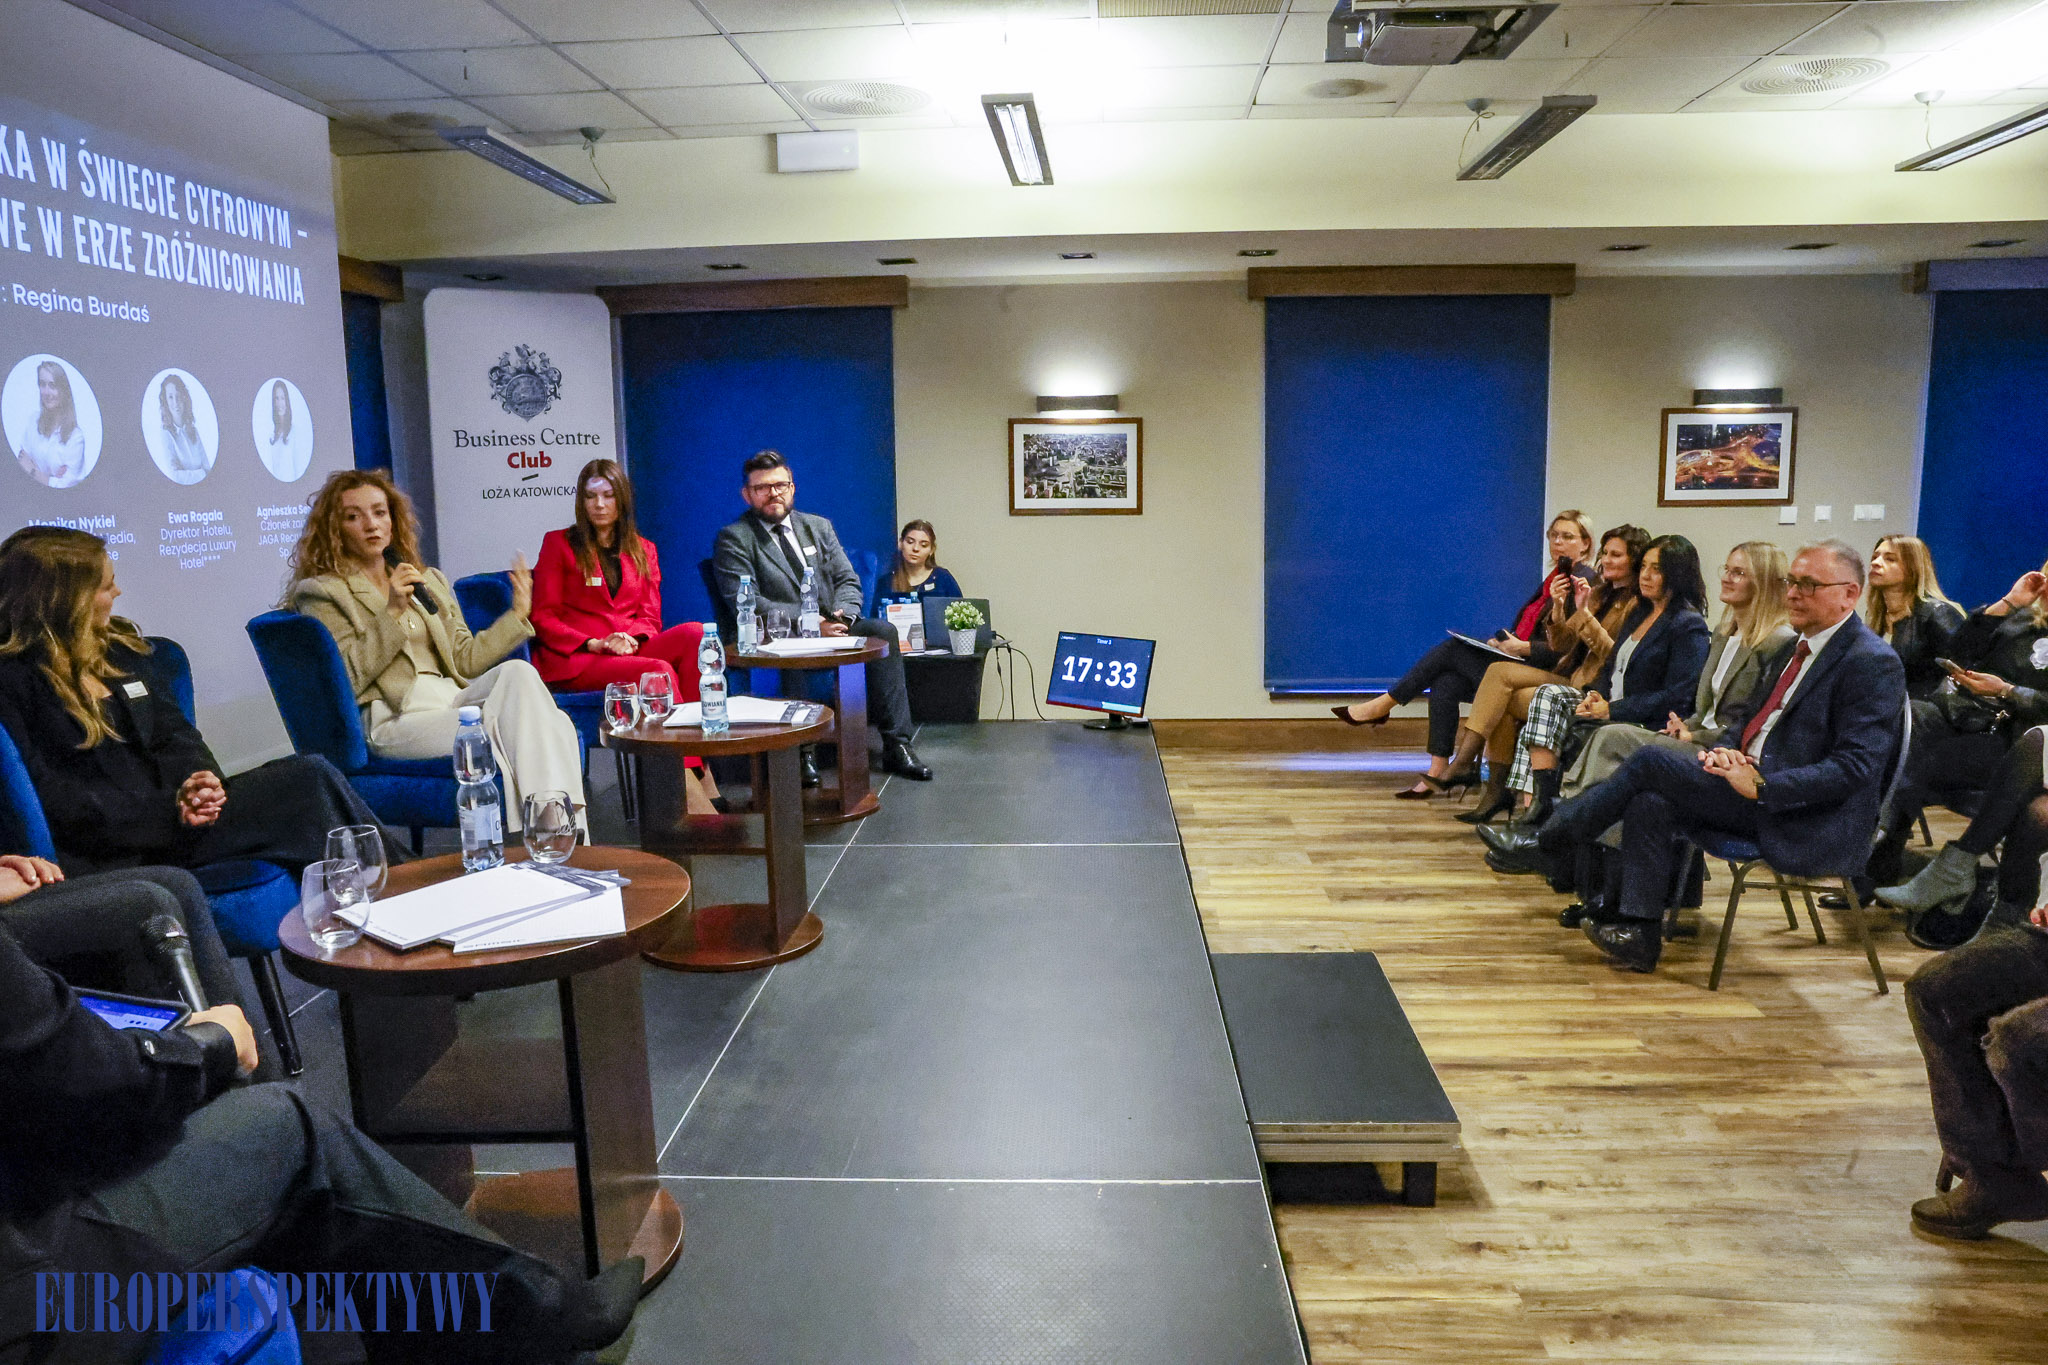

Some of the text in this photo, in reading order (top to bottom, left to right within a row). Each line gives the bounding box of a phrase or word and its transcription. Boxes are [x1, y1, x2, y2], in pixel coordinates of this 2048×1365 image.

[41, 136, 67, 191] W
[77, 138, 179, 221] ŚWIECIE
[184, 181, 291, 249] CYFROWYM
[37, 206, 63, 259] W
[73, 214, 136, 273] ERZE
[141, 230, 305, 305] ZRÓŻNICOWANIA
[12, 283, 150, 323] Regina Burdaś
[453, 427, 600, 448] Business Centre
[507, 451, 552, 469] Club
[482, 486, 577, 499] LOŻA KATOWICKA
[168, 509, 224, 526] Ewa Rogala
[256, 505, 298, 520] Agnieszka
[78, 514, 116, 533] Nykiel
[106, 531, 136, 545] edia,
[160, 527, 200, 543] Dyrektor
[258, 534, 280, 546] JAGA
[159, 540, 236, 557] Rezydecja Luxury
[1061, 655, 1138, 689] 17:33
